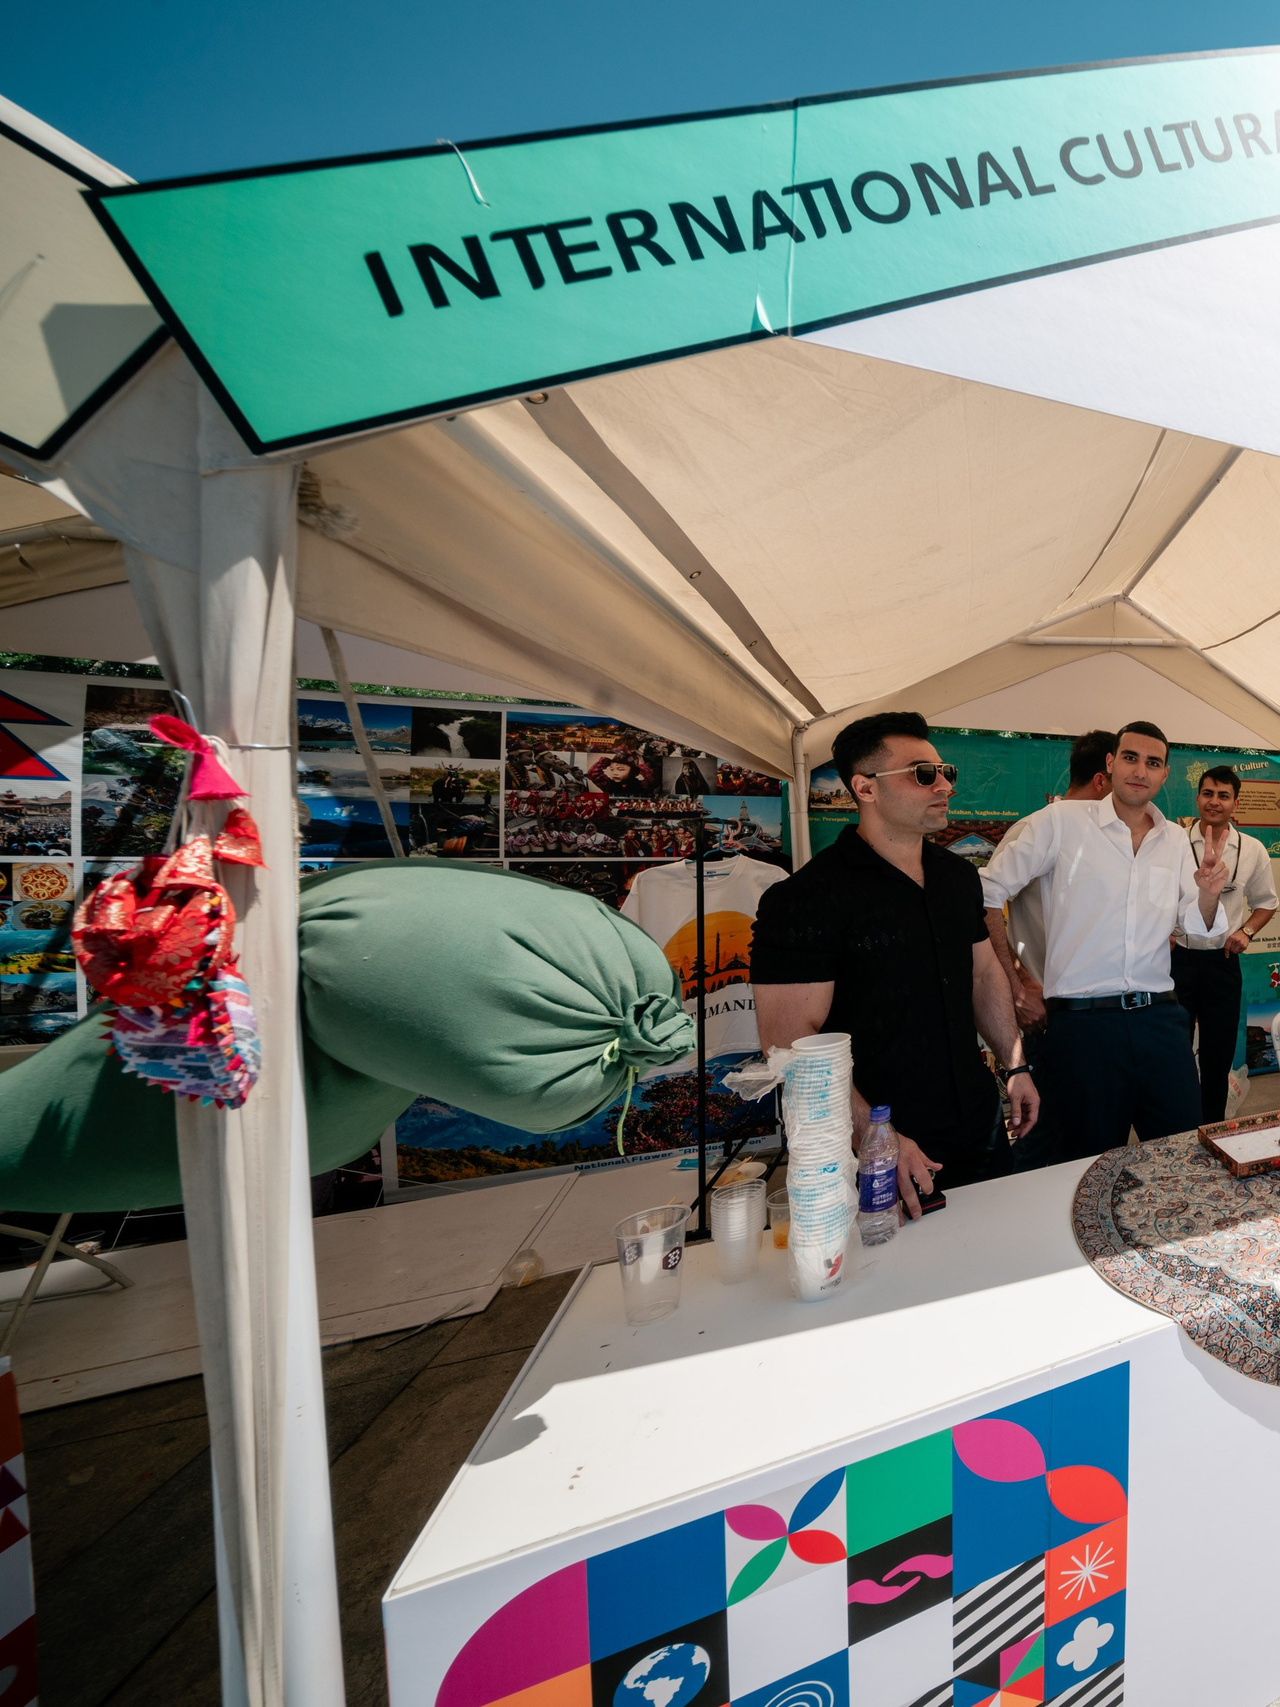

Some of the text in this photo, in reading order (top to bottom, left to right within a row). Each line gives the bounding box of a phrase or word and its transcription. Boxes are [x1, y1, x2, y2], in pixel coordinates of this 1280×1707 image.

[364, 146, 1056, 317] INTERNATIONAL
[1239, 760, 1270, 772] Culture
[574, 1158, 627, 1171] National
[631, 1152, 674, 1163] Flower
